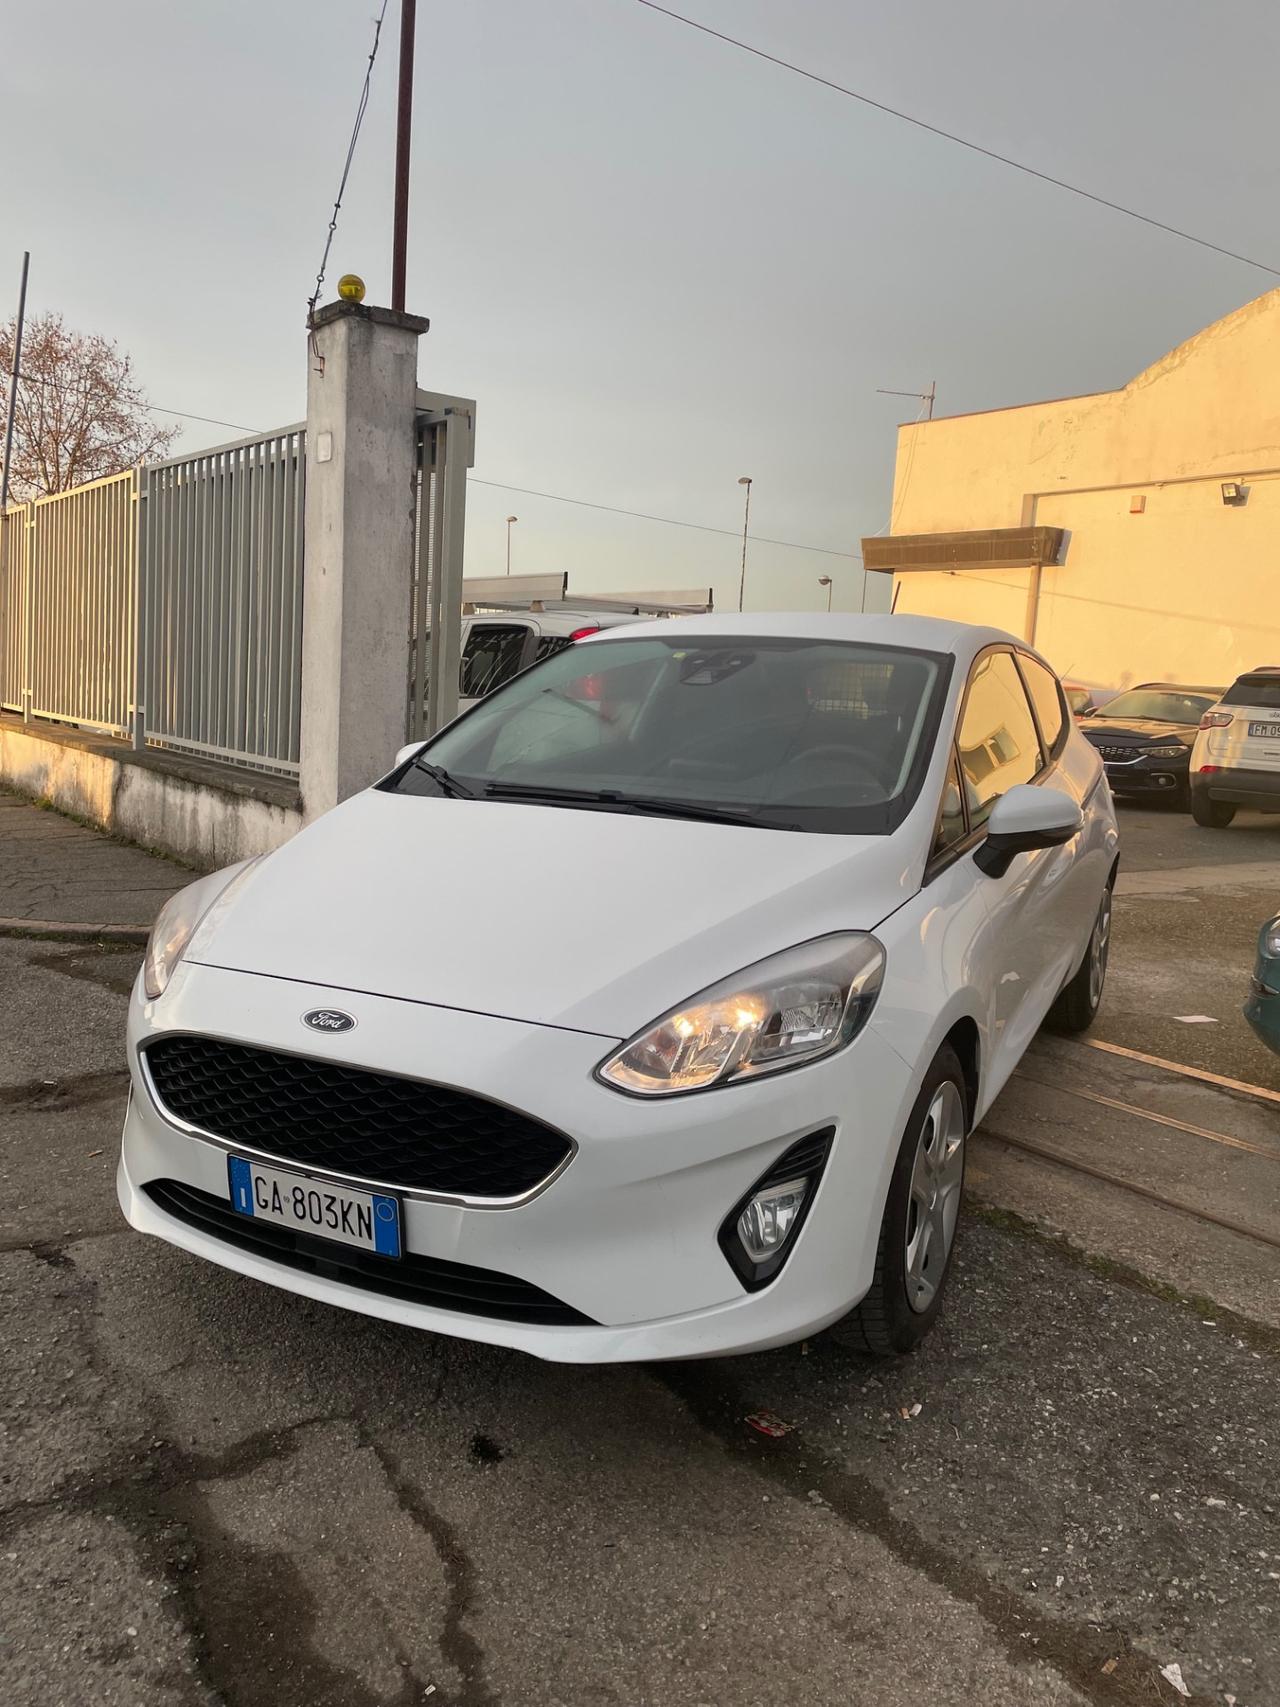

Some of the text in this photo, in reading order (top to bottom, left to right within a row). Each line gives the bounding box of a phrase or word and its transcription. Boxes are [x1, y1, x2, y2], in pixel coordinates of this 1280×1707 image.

[311, 1011, 345, 1029] Ford
[254, 1176, 373, 1241] GA 803KN
